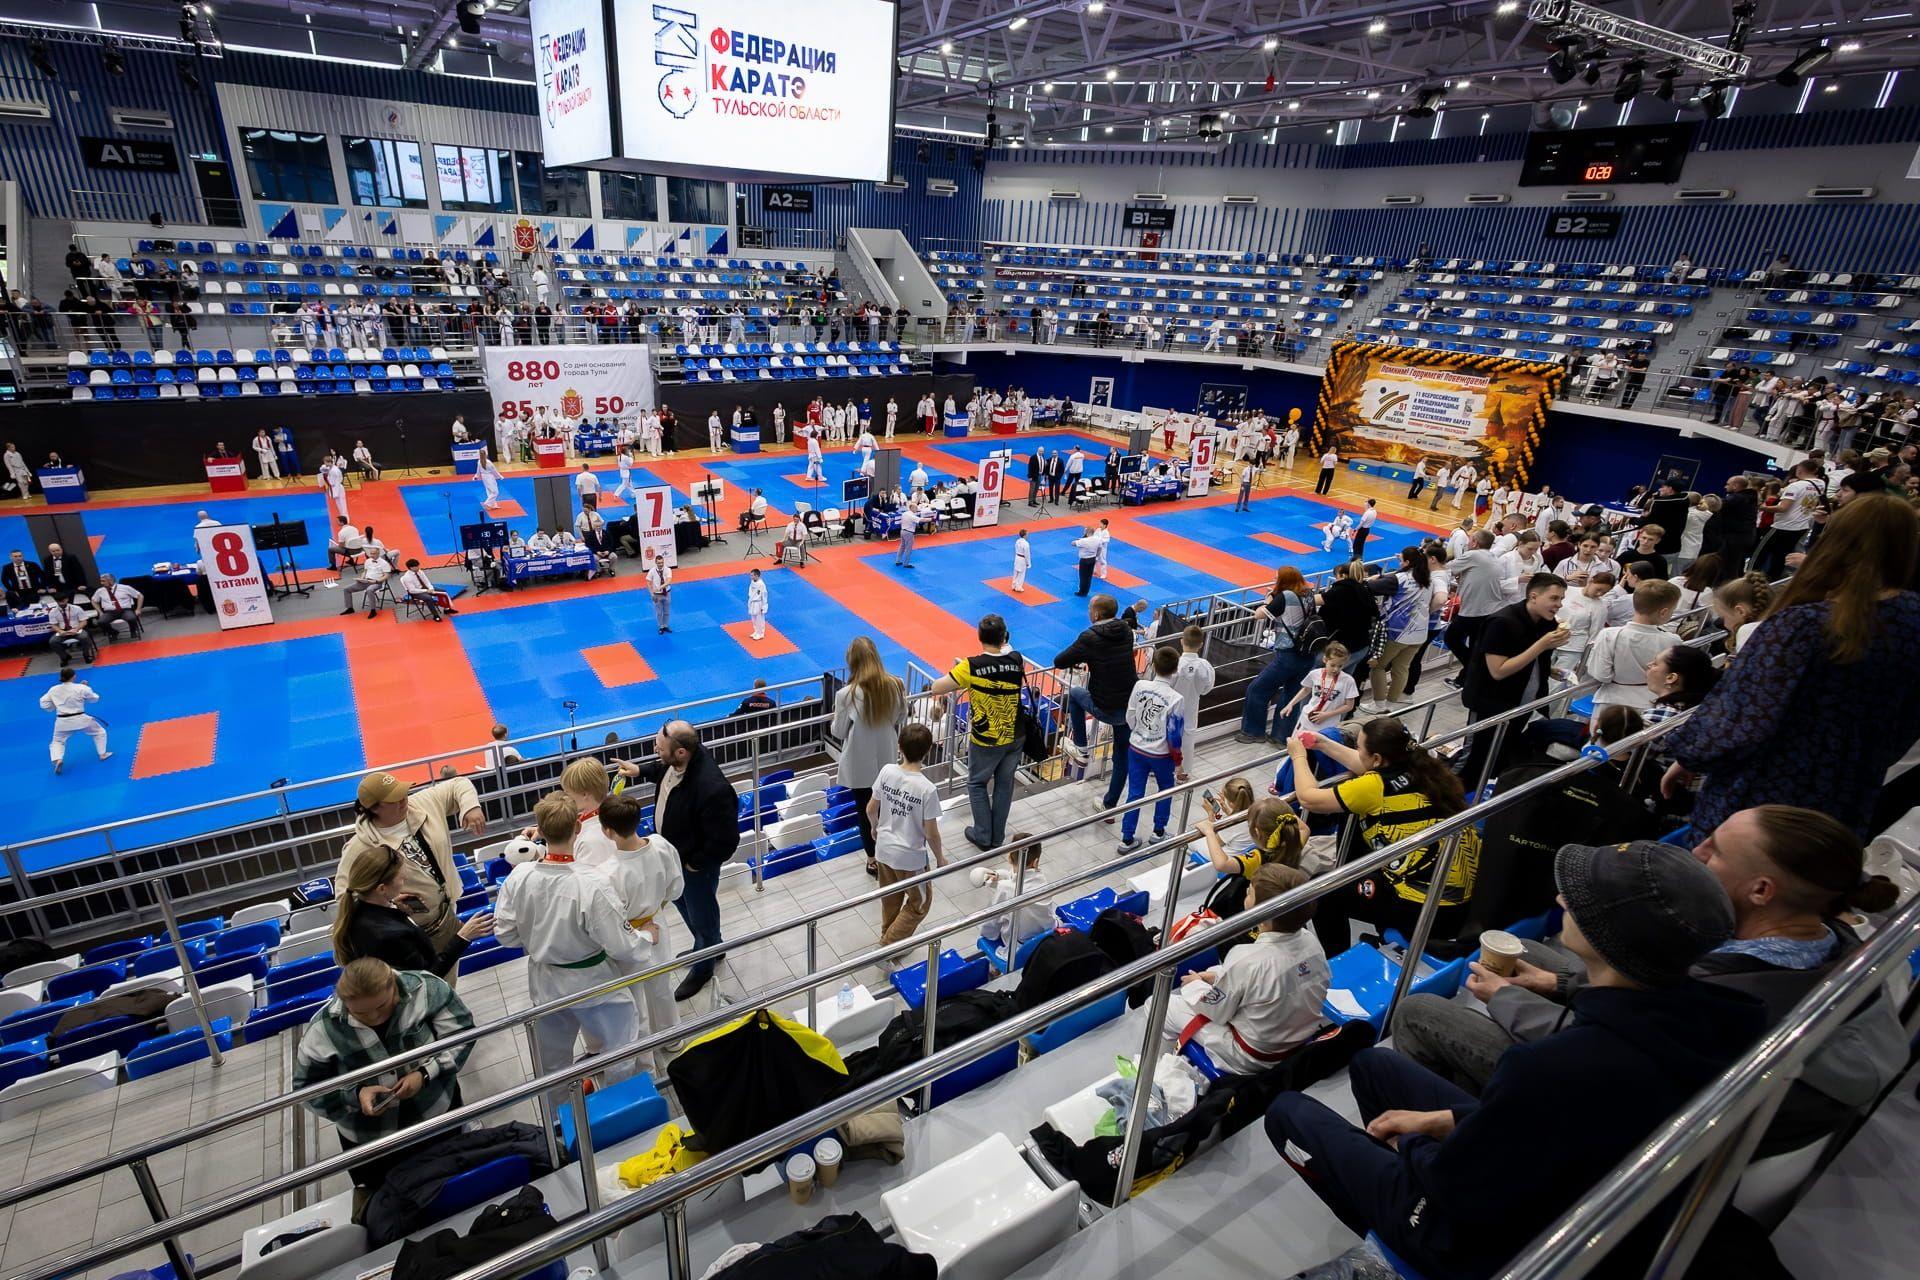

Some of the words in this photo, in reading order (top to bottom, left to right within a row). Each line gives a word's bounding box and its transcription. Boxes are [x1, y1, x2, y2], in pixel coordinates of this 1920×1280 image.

[553, 27, 586, 63] ФЕДЕРАЦИЯ
[710, 27, 836, 74] ФЕДЕРАЦИЯ
[555, 63, 580, 96] КАРАТЭ
[711, 63, 806, 100] КАРАТЭ
[711, 97, 787, 118] ТУЛЬСКОЙ
[789, 104, 841, 122] ОБЛАСТИ
[1555, 217, 1588, 233] B2
[507, 360, 560, 382] 880
[564, 370, 589, 378] города
[501, 400, 534, 420] 85
[595, 396, 624, 415] 50
[1196, 439, 1211, 465] 5
[983, 461, 999, 491] 6
[1356, 464, 1368, 472] 2
[645, 491, 664, 528] 7
[642, 528, 672, 538] татами
[211, 531, 250, 577] 8
[214, 576, 259, 589] татами
[975, 665, 997, 676] ПУТЬ
[902, 791, 922, 805] Team
